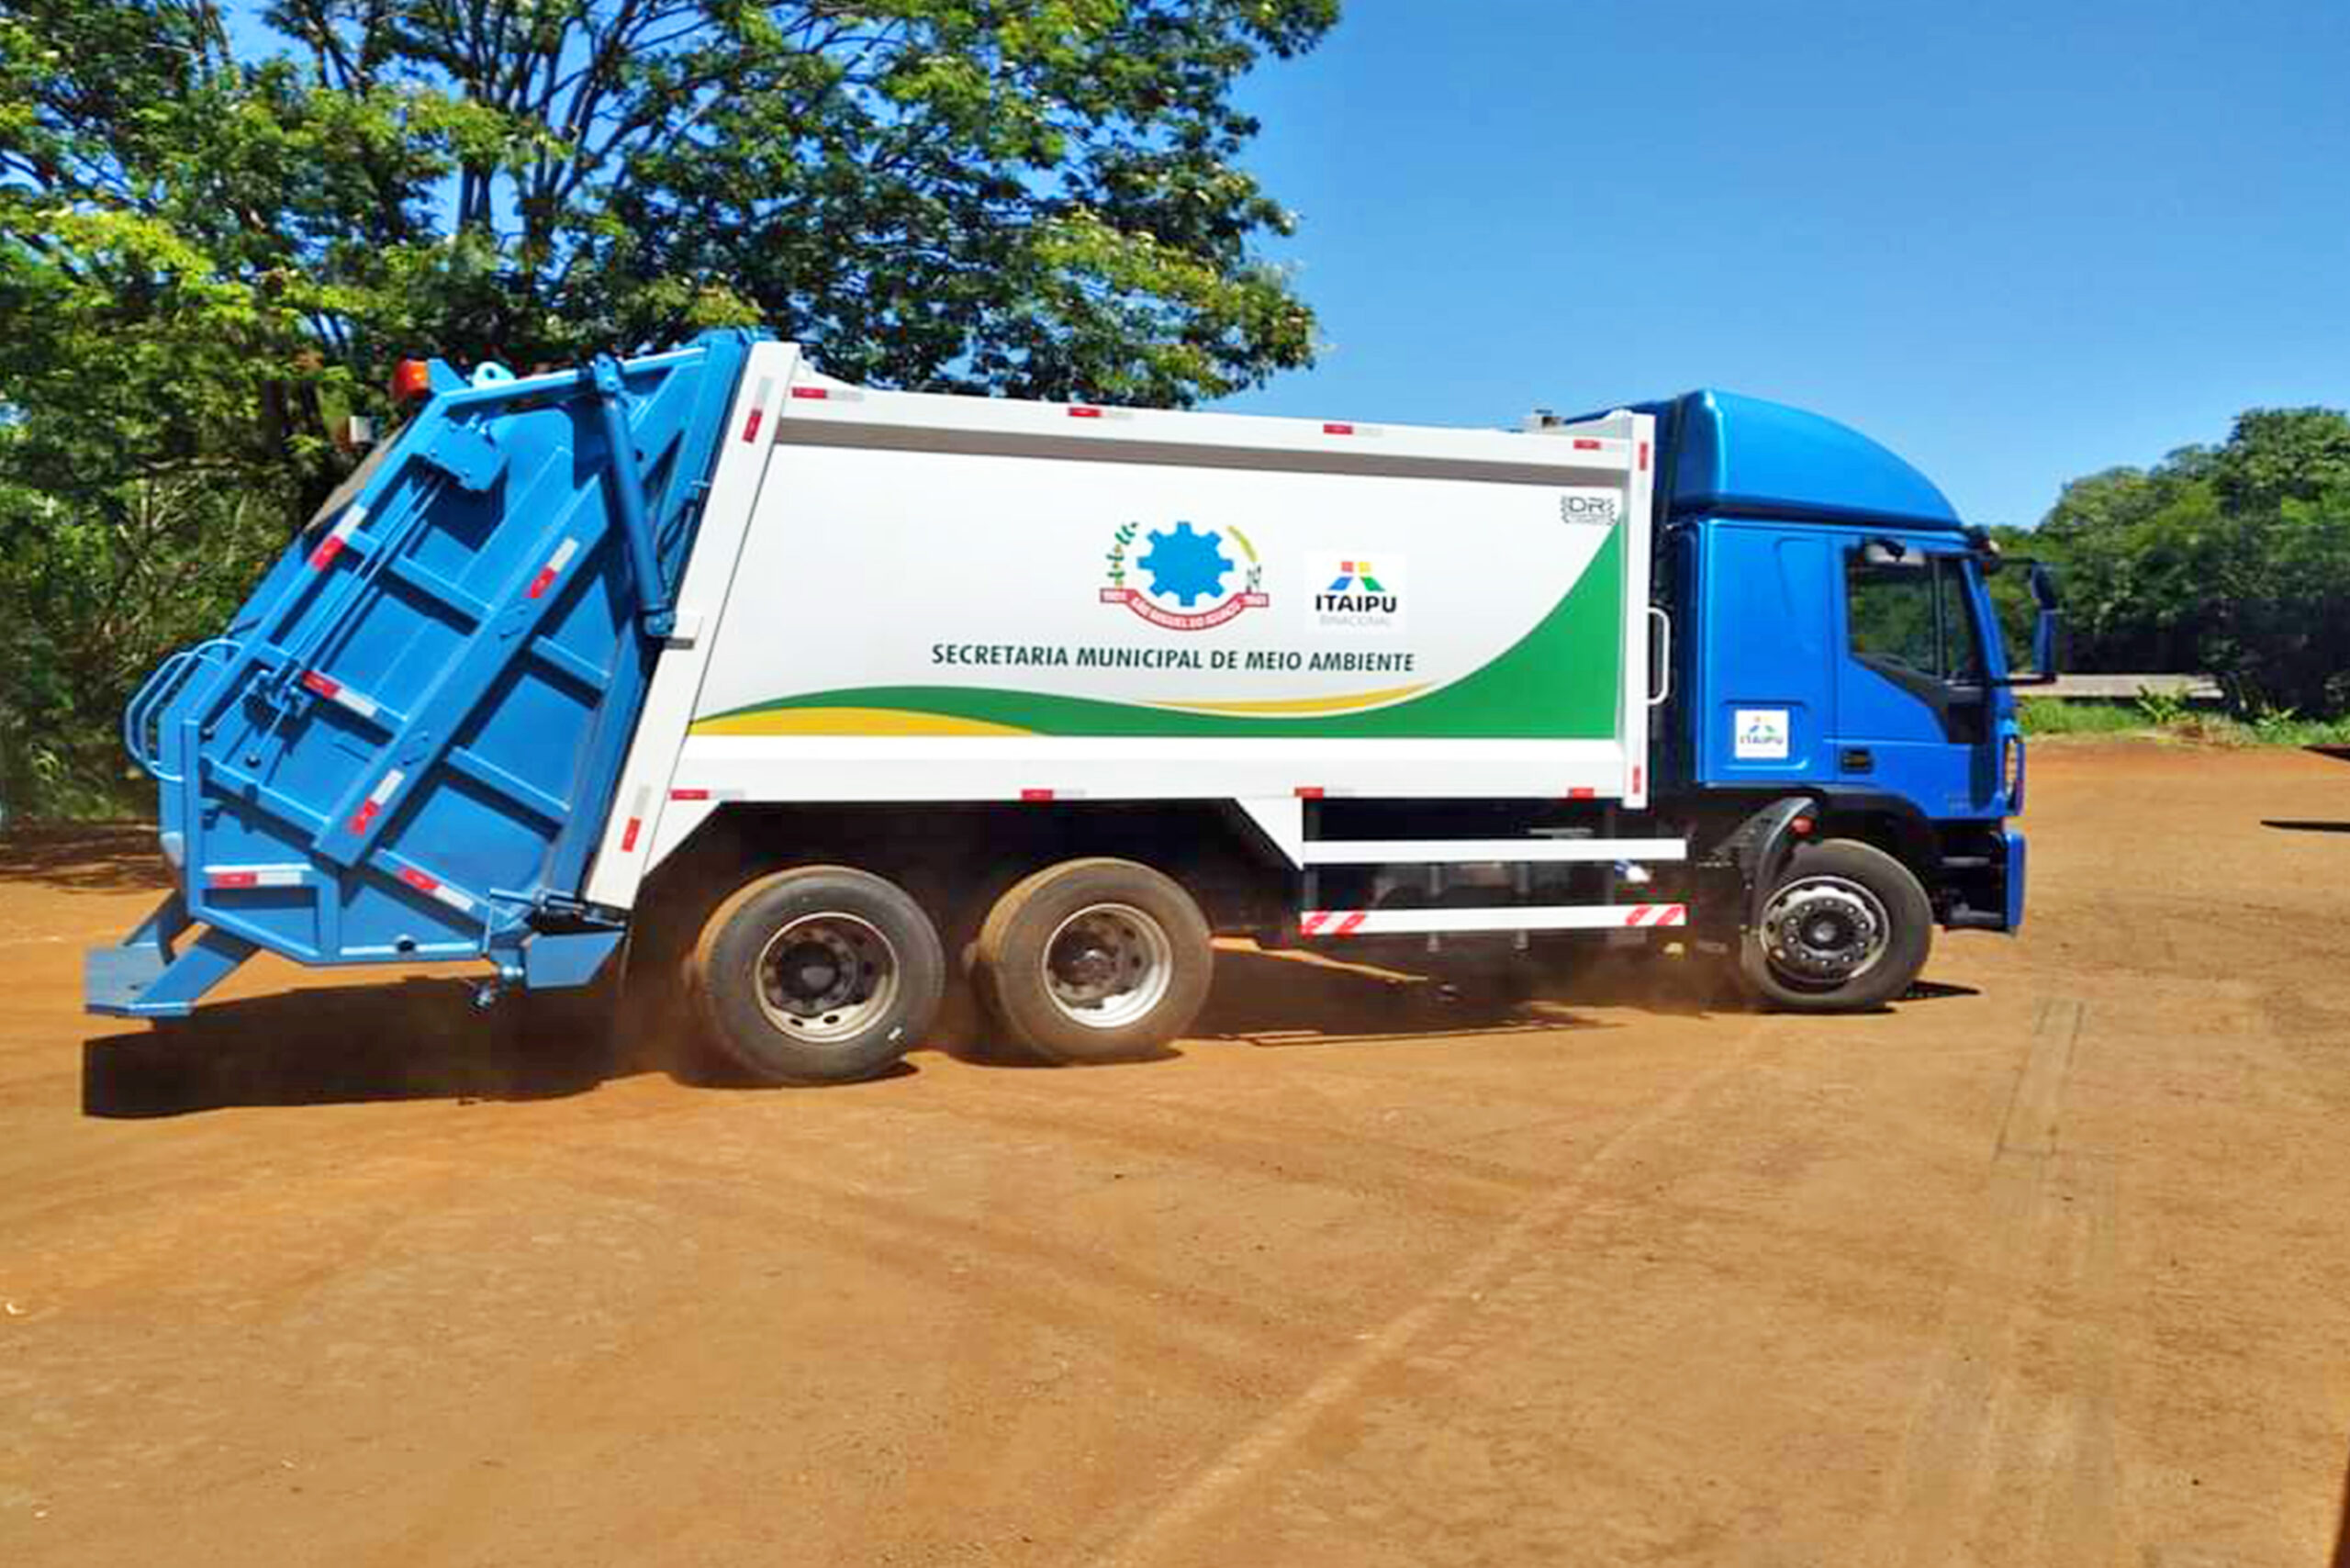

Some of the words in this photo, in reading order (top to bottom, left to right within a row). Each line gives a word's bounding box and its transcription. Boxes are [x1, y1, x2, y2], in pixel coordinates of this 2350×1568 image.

[1315, 594, 1397, 613] ITAIPU
[931, 644, 1069, 666] SECRETARIA
[1076, 647, 1203, 669] MUNICIPAL
[1210, 650, 1238, 669] DE
[1245, 651, 1303, 671] MEIO
[1308, 652, 1415, 672] AMBIENTE
